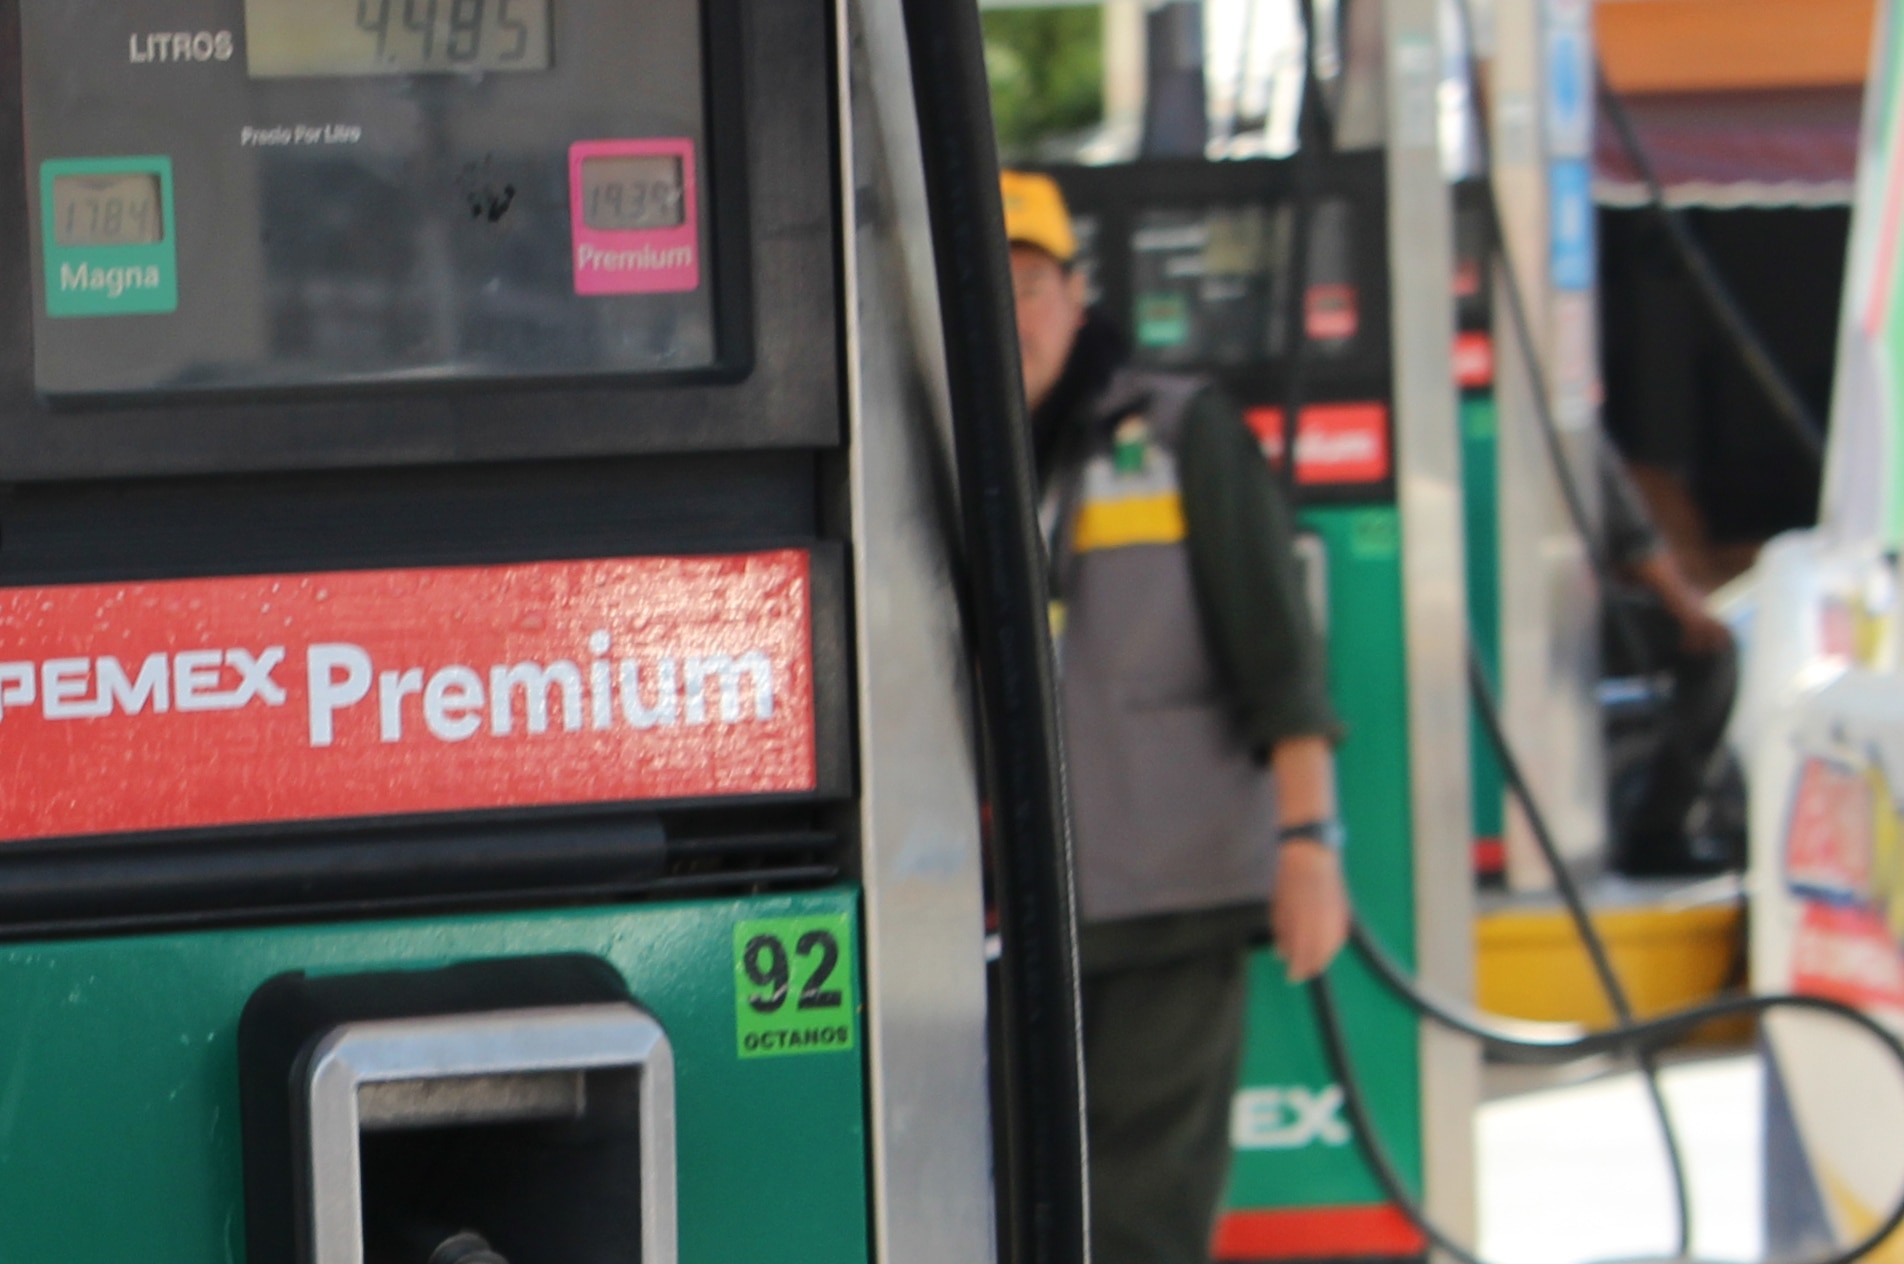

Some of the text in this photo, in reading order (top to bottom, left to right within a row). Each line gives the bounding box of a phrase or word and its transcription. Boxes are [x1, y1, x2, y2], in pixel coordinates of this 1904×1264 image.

[130, 30, 234, 63] LITROS
[294, 124, 323, 145] Por
[578, 242, 693, 272] Premium
[60, 262, 159, 298] Magna
[306, 631, 774, 747] Premium
[743, 929, 843, 1016] 92
[743, 1025, 849, 1051] OCTANOS
